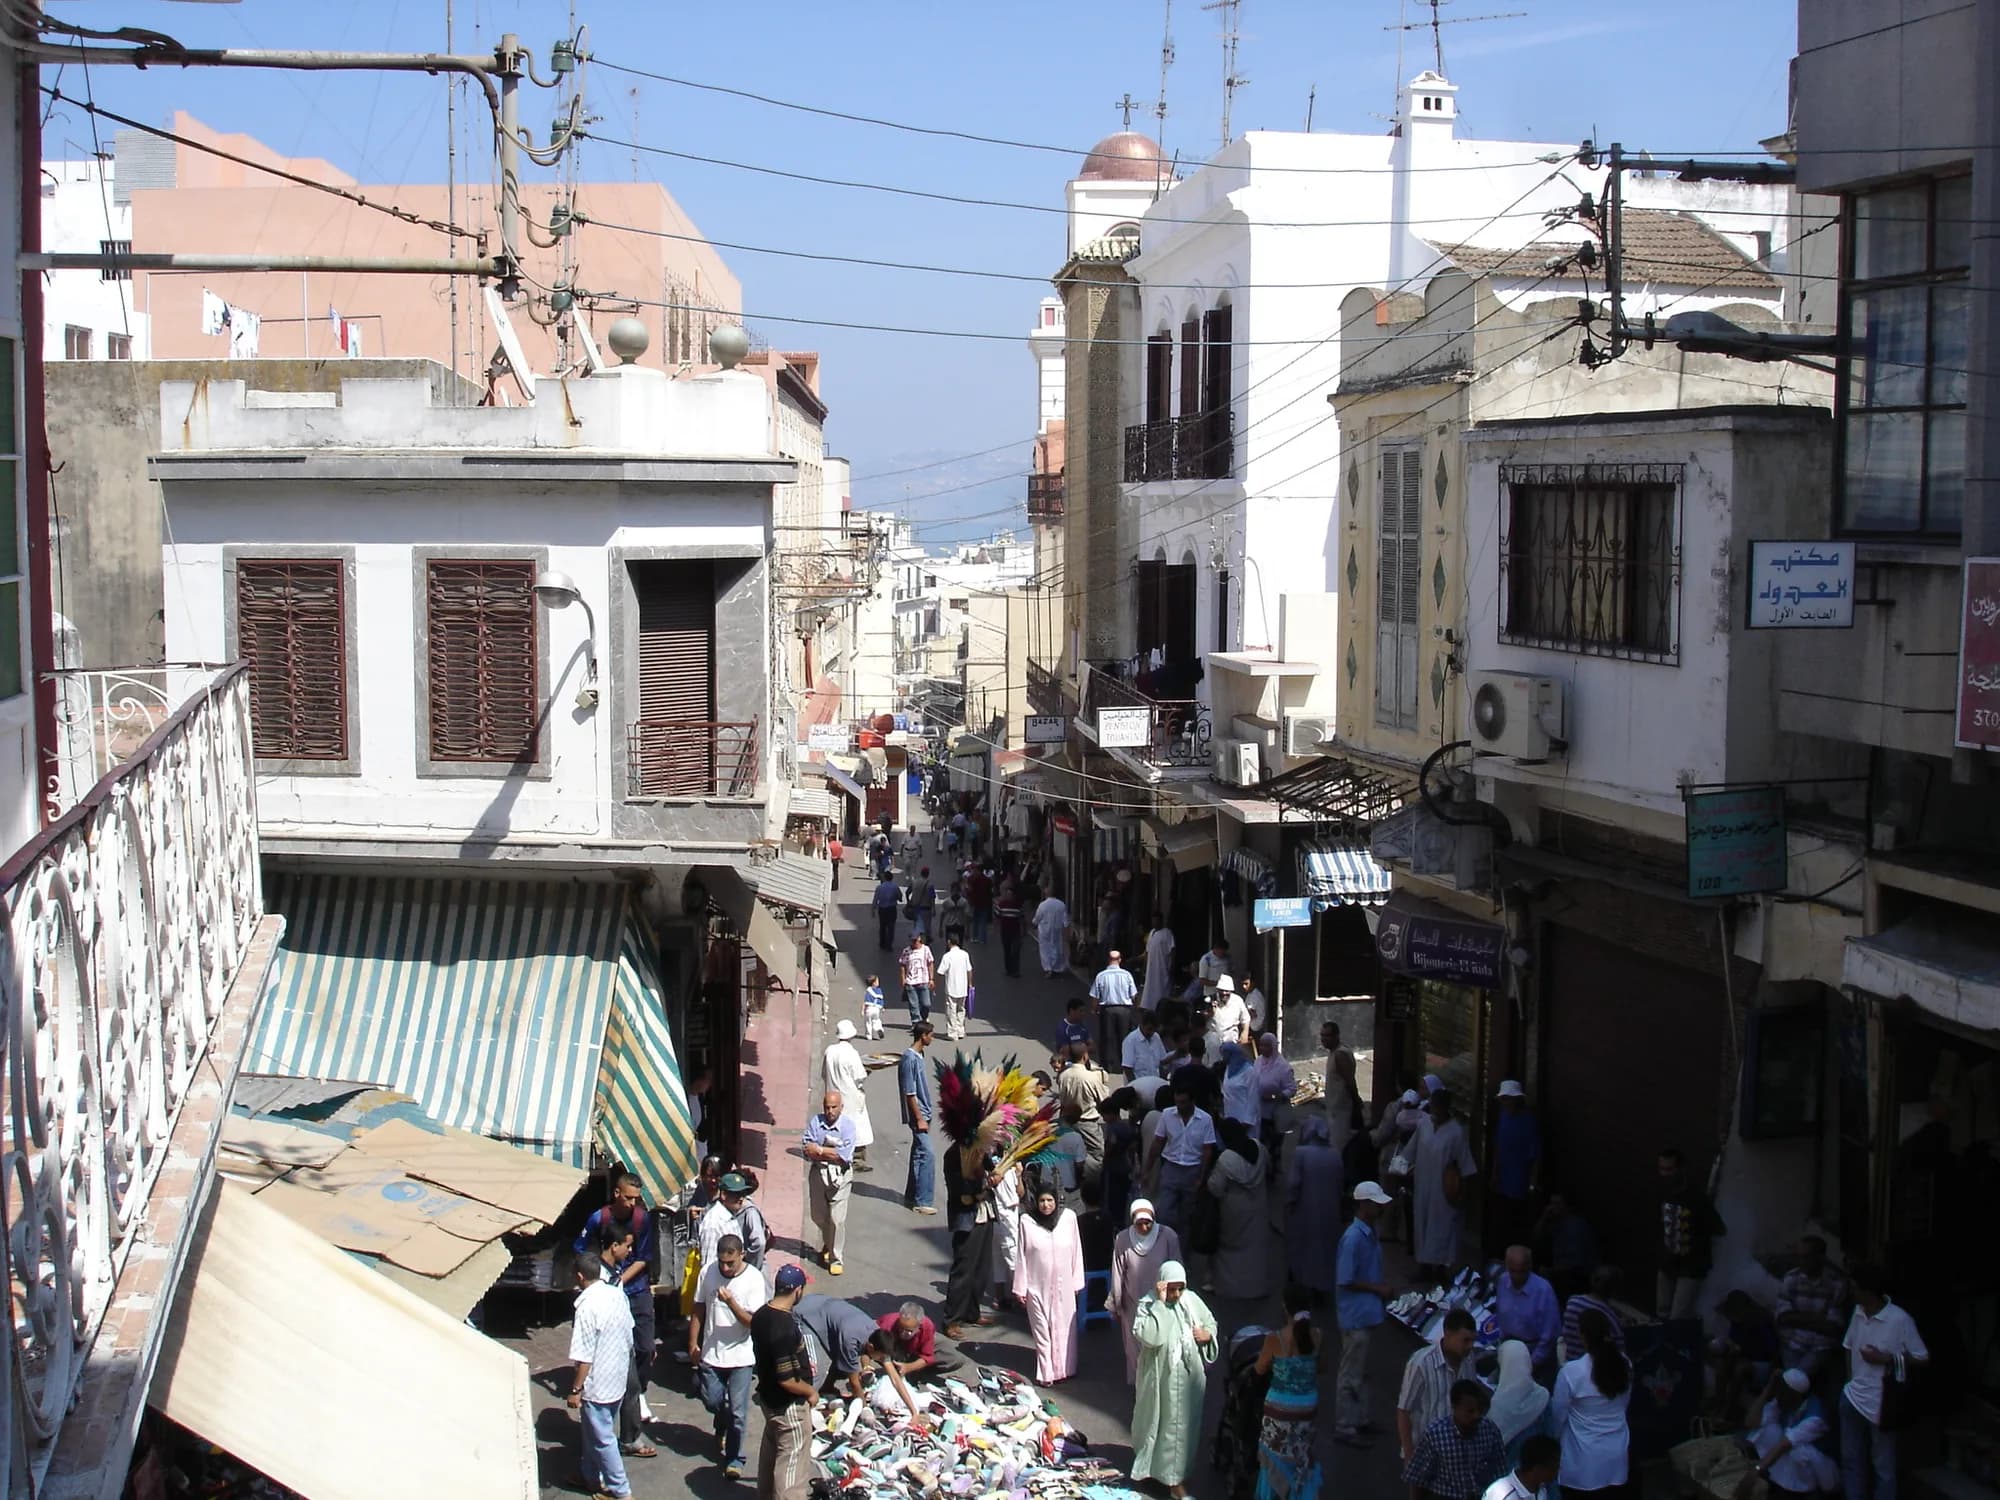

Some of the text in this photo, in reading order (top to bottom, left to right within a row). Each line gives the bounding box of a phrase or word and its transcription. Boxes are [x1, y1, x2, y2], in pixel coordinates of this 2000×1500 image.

[1769, 547, 1839, 573] مكتب
[1760, 579, 1847, 606] العدول
[1031, 718, 1060, 728] BAZAR
